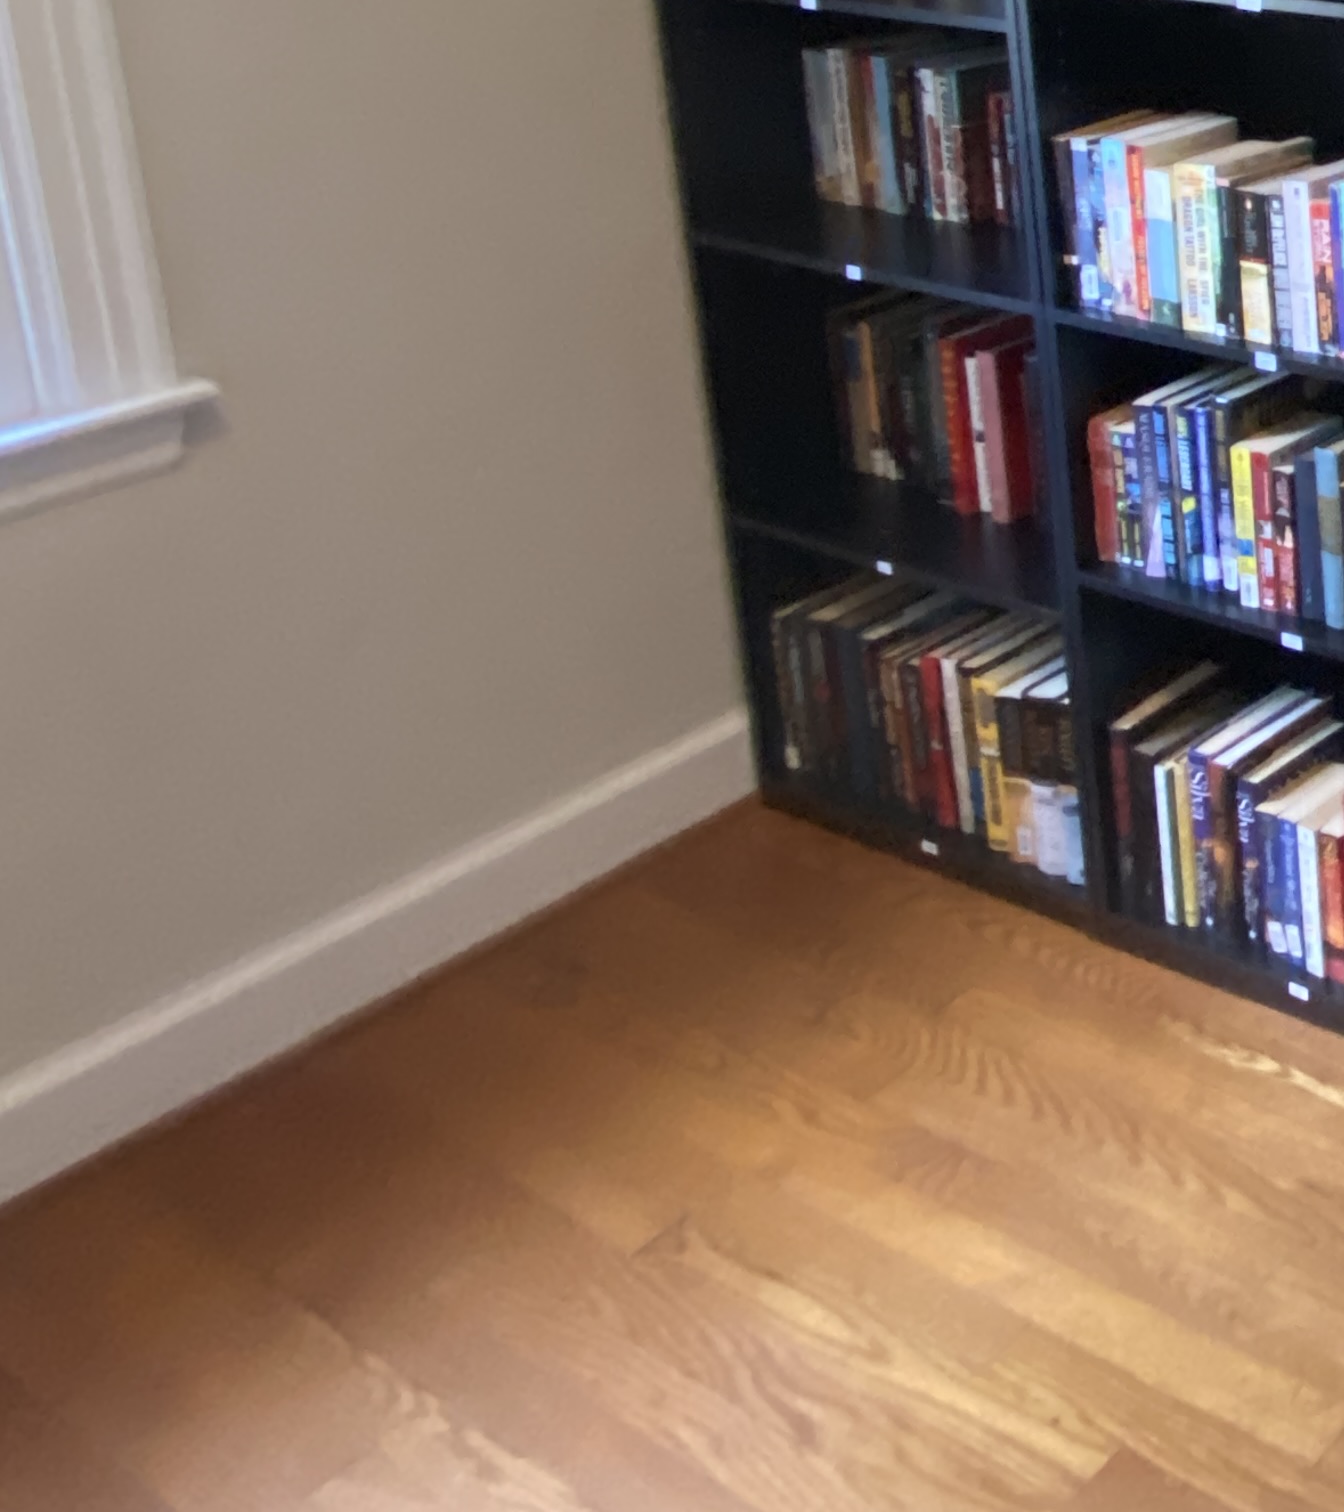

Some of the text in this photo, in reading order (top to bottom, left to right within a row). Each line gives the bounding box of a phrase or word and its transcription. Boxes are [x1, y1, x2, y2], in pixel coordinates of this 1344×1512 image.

[1182, 196, 1194, 266] DRAGON TATTOO
[1195, 189, 1208, 272] THE GIRL WITH THE
[1187, 279, 1198, 318] LARSSON
[1190, 769, 1211, 821] Silva
[1236, 793, 1255, 843] Silva
